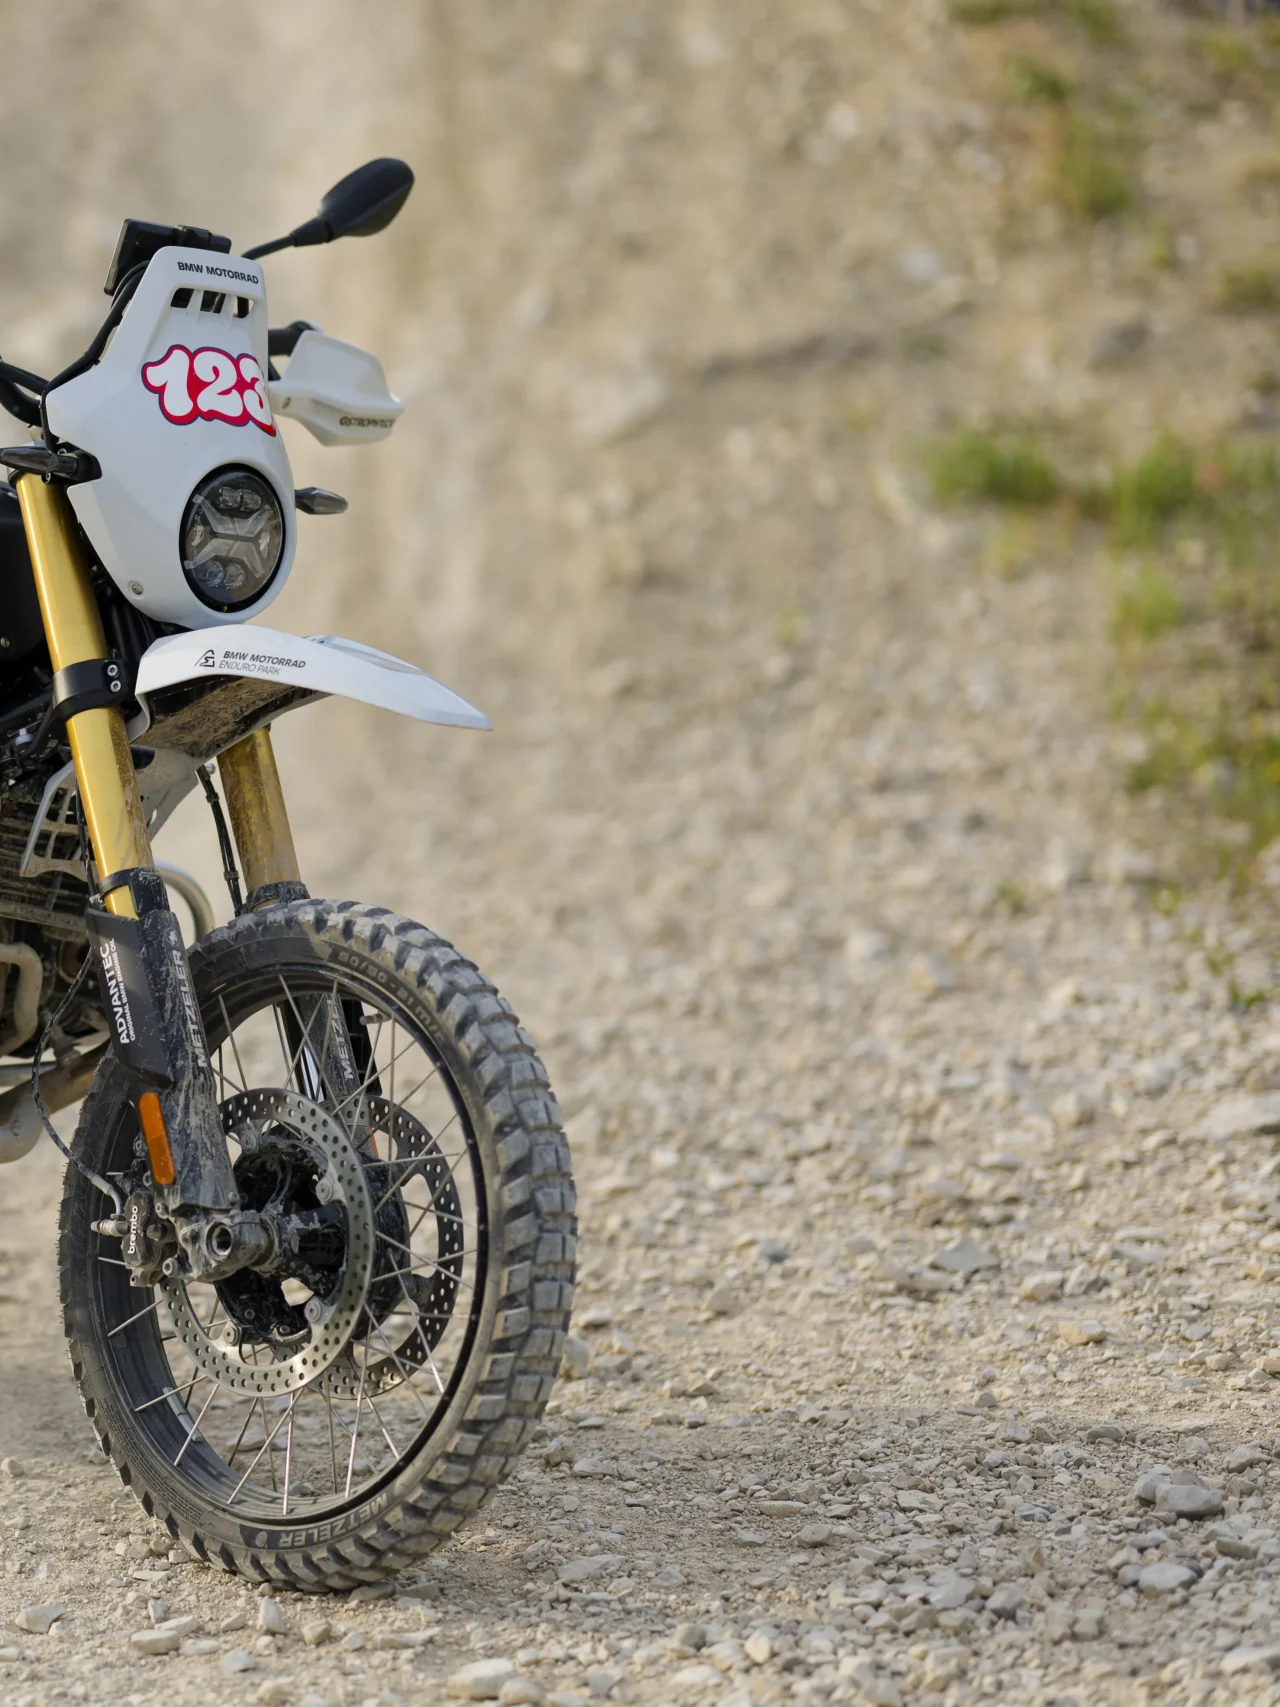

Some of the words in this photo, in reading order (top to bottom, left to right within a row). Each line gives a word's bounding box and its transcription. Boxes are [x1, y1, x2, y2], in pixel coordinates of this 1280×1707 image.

[177, 262, 204, 273] BMW
[205, 265, 260, 285] MOTORRAD
[141, 344, 276, 437] 123
[218, 660, 257, 673] ENDURO
[256, 664, 282, 676] PARK
[223, 650, 249, 661] BMW
[249, 653, 307, 669] MOTORRAD
[109, 937, 117, 952] OIL
[111, 951, 124, 983] ENGINE
[99, 942, 130, 1045] ADVANTEC
[118, 982, 128, 1004] BMW
[172, 949, 207, 1068] METZELER
[123, 1002, 136, 1042] ORIGINAL
[127, 1205, 139, 1255] brembo
[278, 1492, 389, 1548] METZELER
